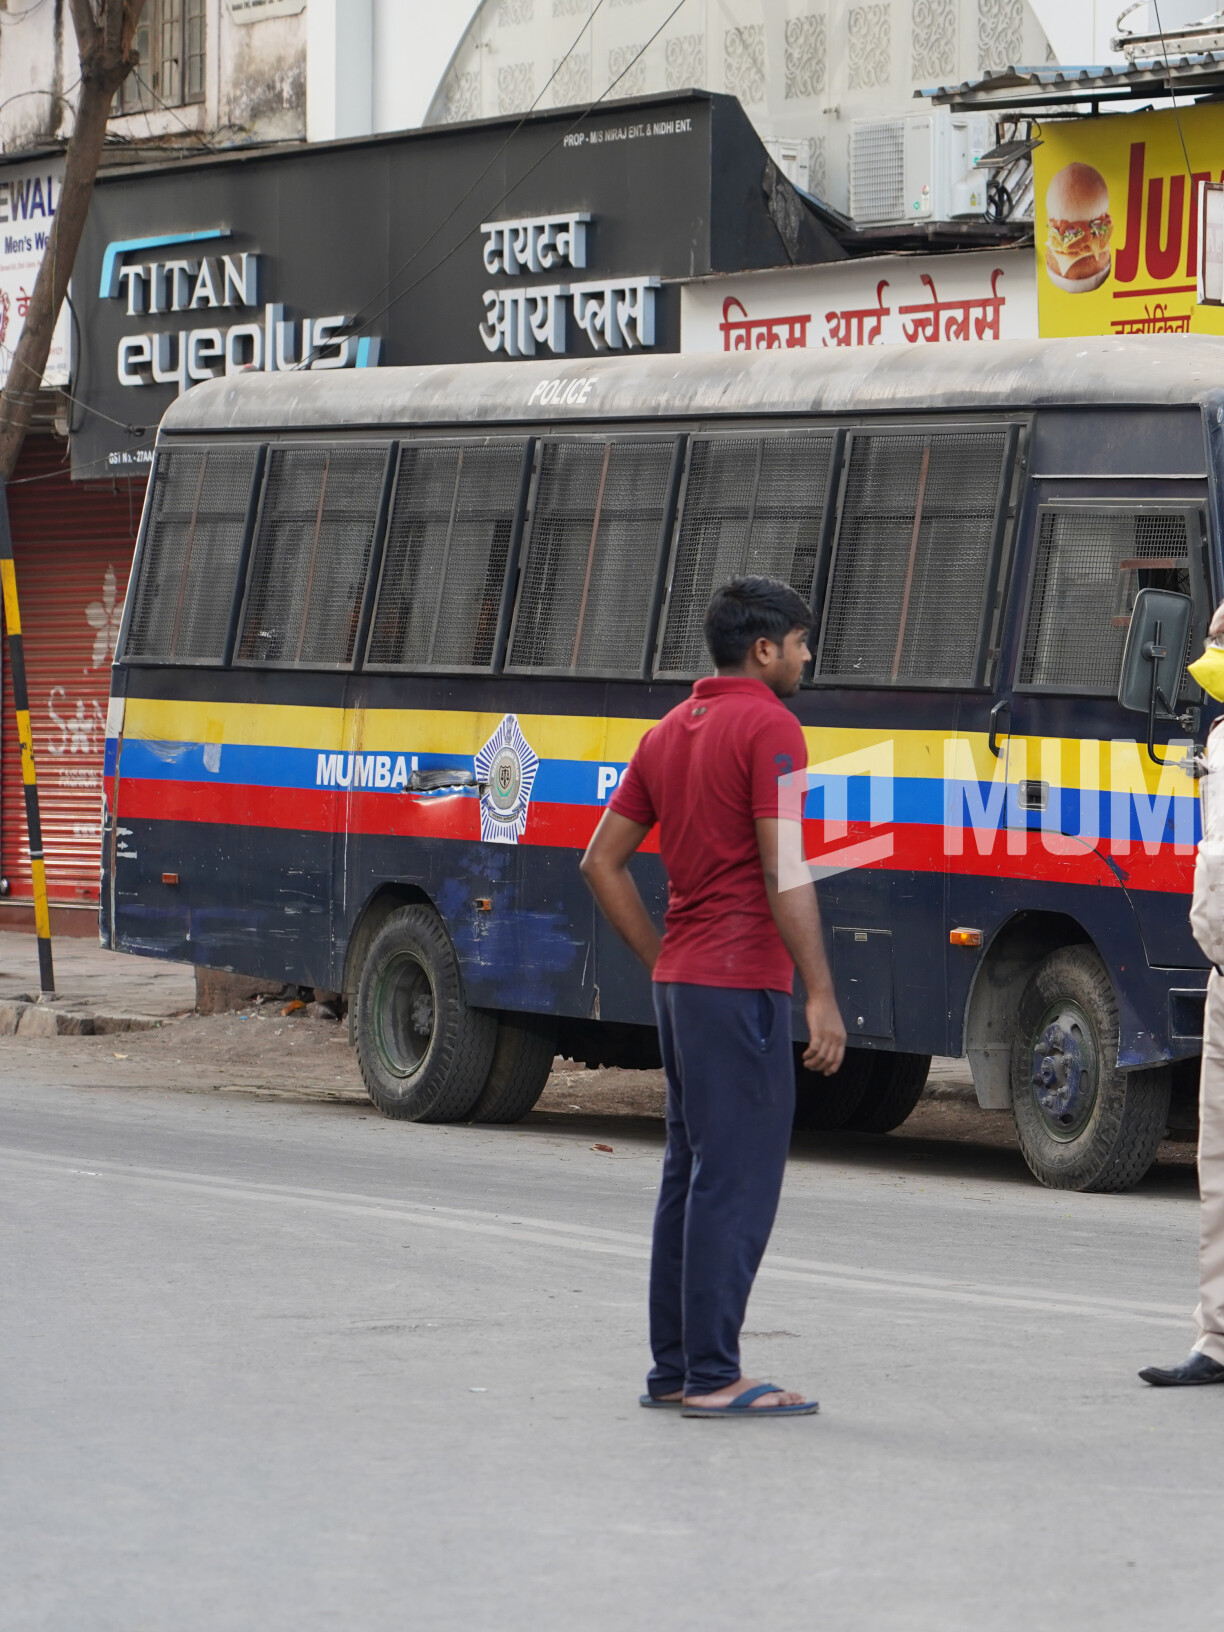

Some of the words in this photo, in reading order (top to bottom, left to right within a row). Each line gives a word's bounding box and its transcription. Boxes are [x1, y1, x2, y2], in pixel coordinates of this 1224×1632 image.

[563, 134, 585, 148] PROP
[653, 121, 674, 135] NIDHI
[5, 234, 32, 254] Men's
[34, 232, 49, 251] We
[480, 212, 591, 275] टायटन
[118, 252, 258, 316] TITAN
[479, 284, 570, 356] आय
[569, 276, 661, 350] प्लस
[117, 302, 358, 396] eyeplus
[528, 377, 599, 406] POLICE
[316, 753, 419, 791] MUMBAI
